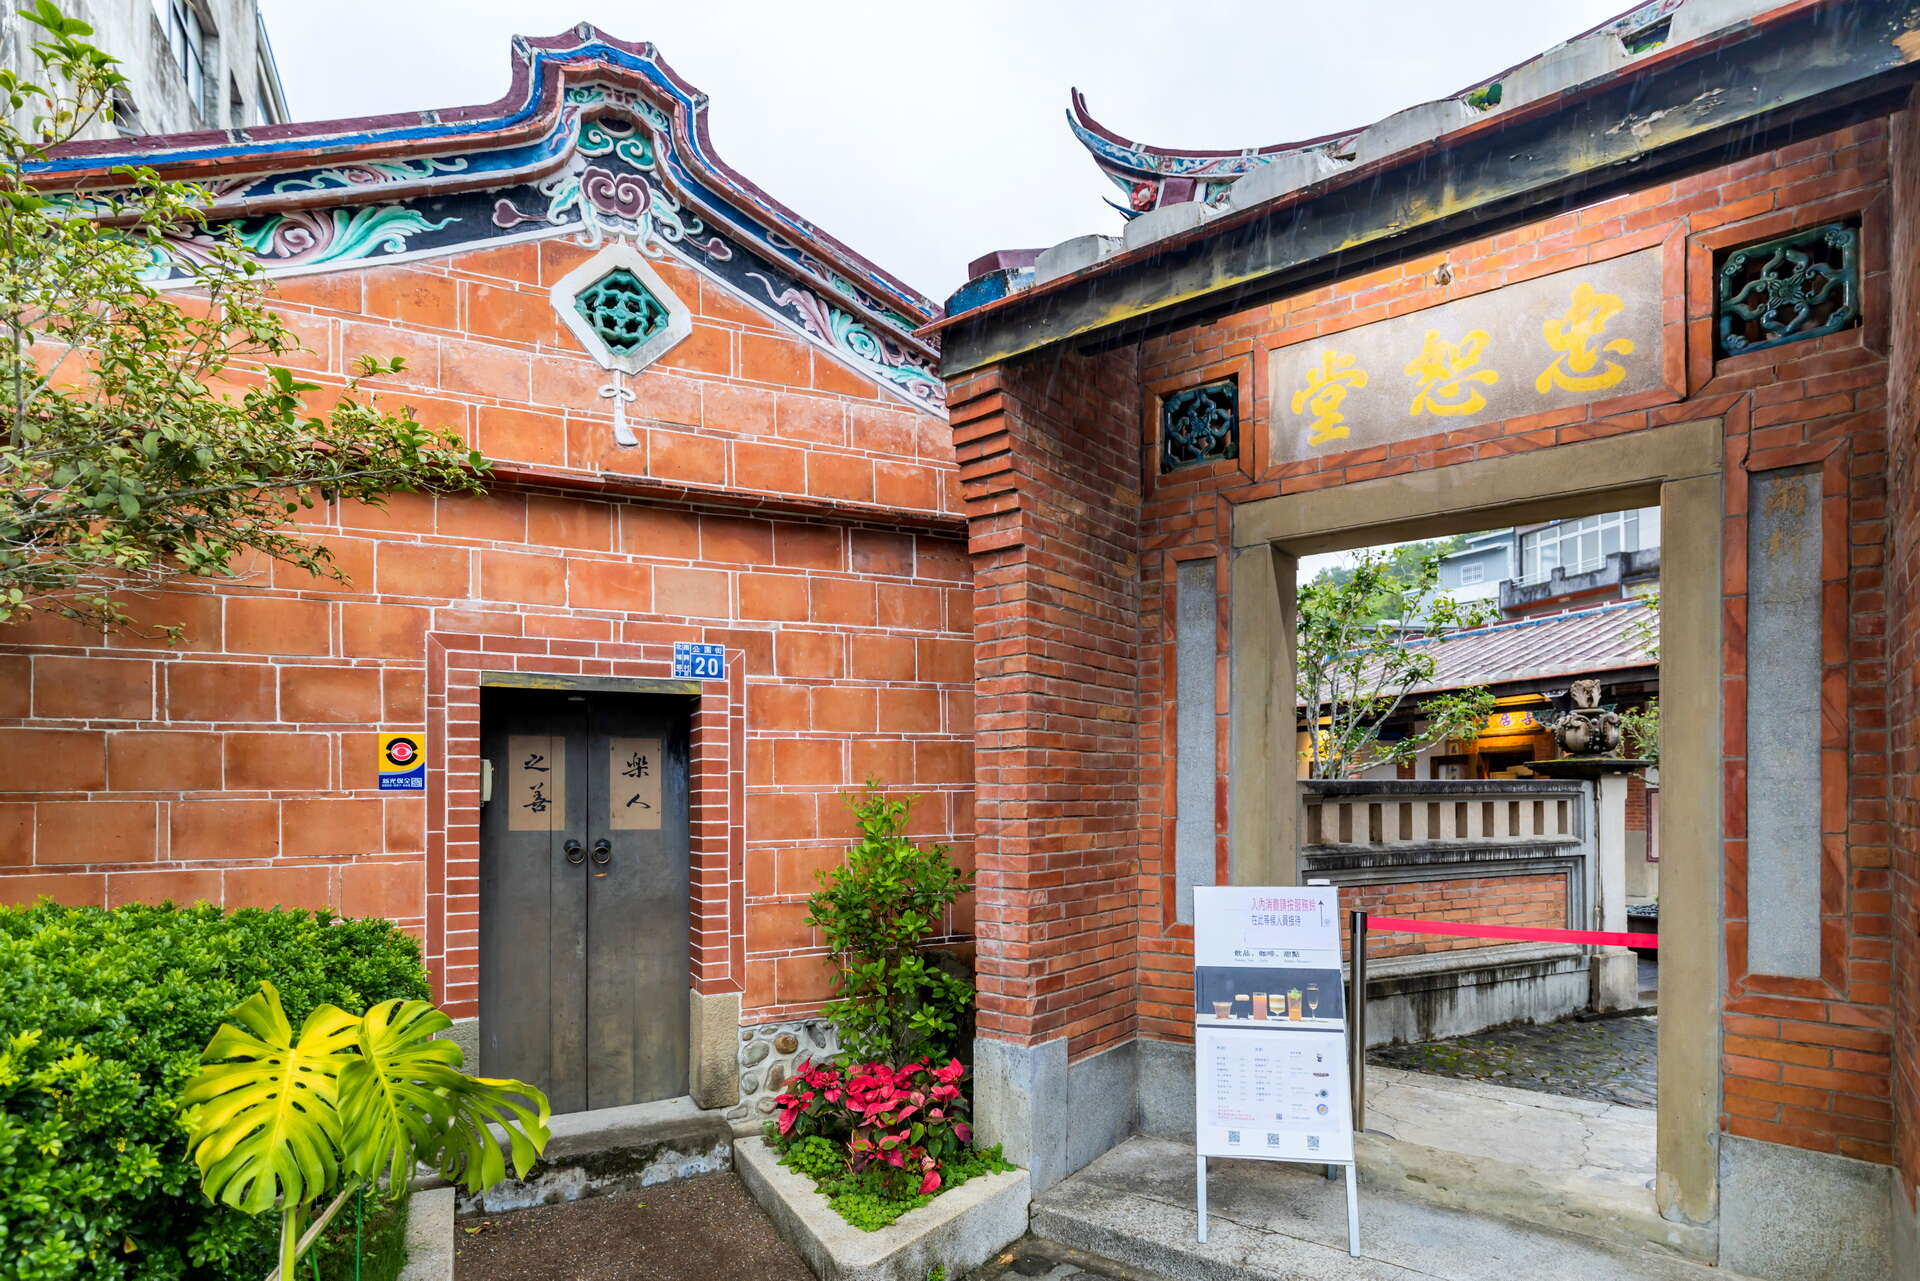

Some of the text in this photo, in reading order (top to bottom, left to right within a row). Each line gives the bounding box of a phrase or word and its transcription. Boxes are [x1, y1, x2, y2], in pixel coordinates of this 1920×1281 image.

[1291, 282, 1633, 447] 忠恕堂
[695, 657, 718, 676] 20
[522, 754, 552, 812] 之善
